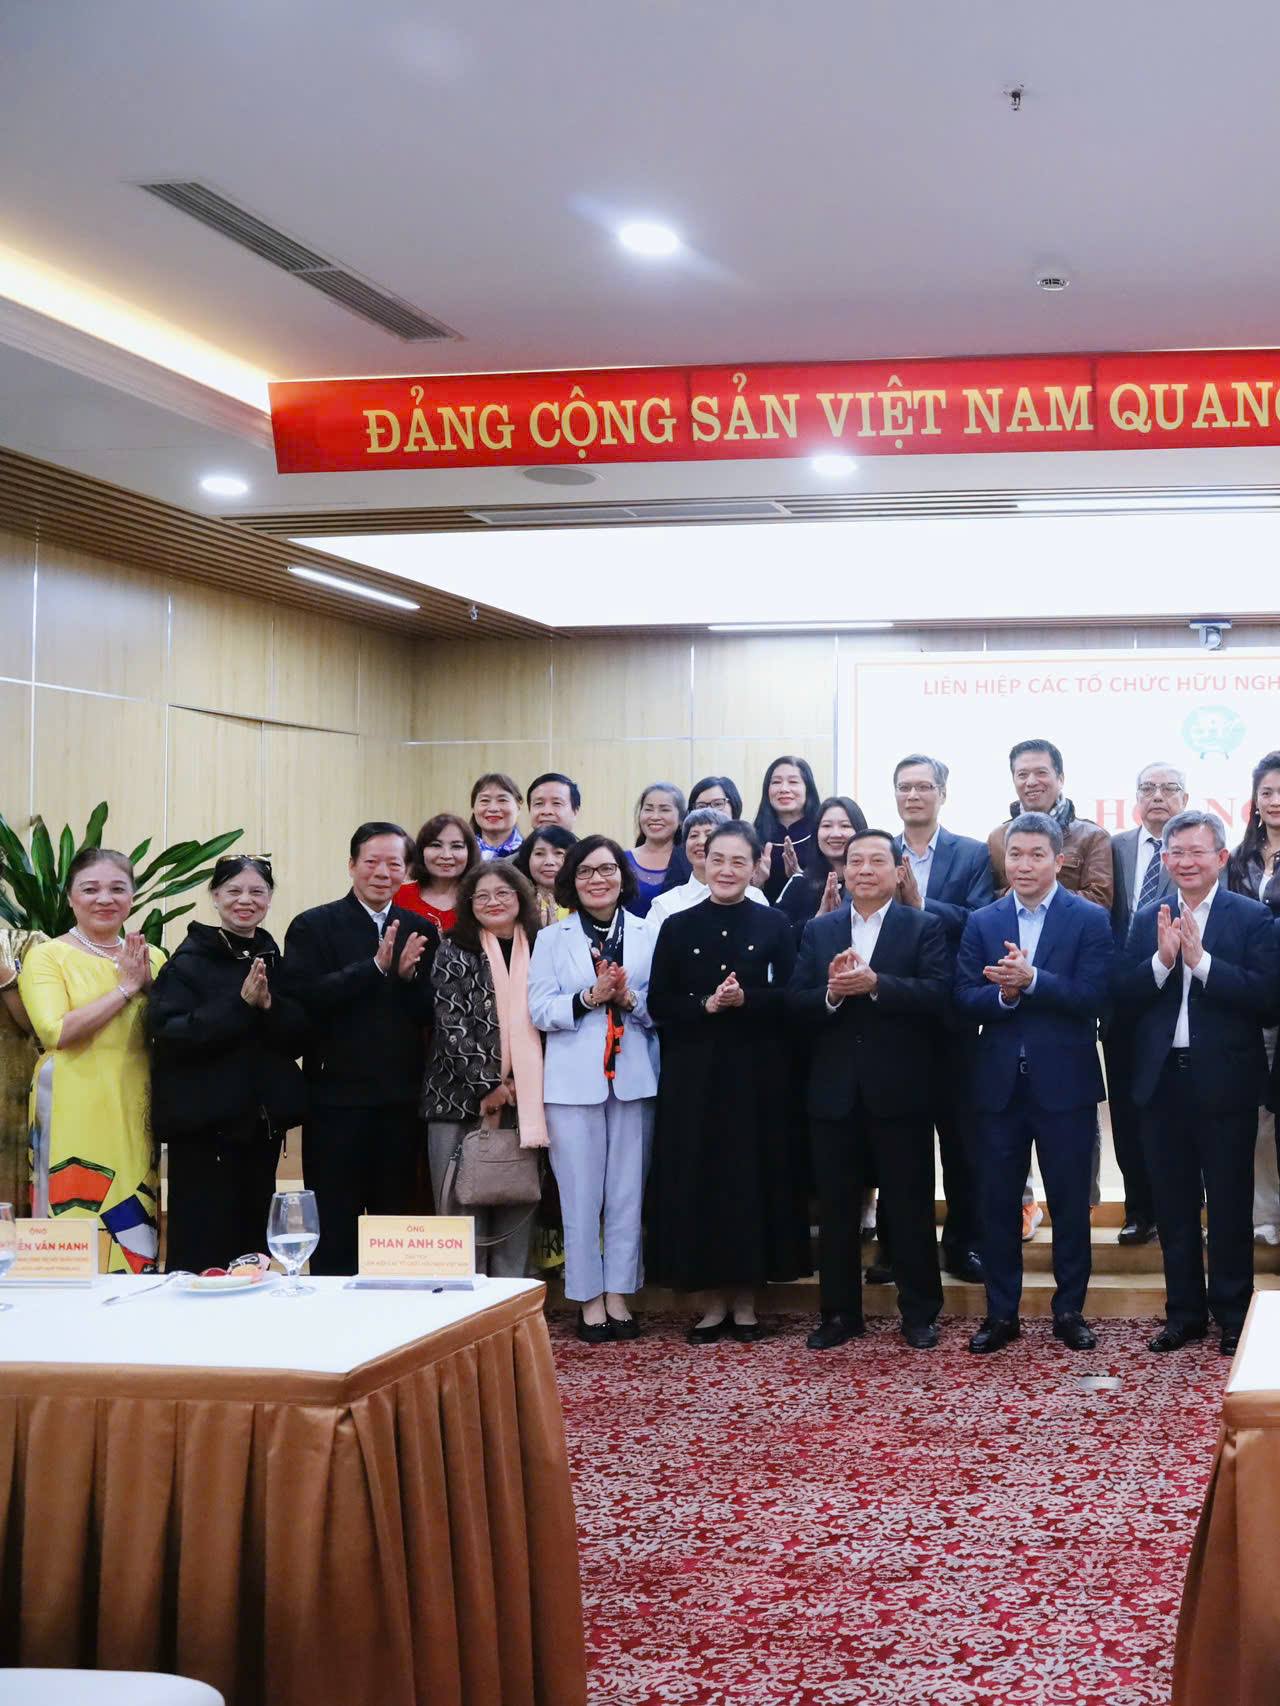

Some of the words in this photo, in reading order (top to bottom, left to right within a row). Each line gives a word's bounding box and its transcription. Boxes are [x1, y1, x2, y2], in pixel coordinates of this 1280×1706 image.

[362, 385, 515, 454] ĐẢNG
[529, 384, 677, 459] CỘNG
[690, 372, 800, 443] SẢN
[816, 374, 947, 449] VIỆT
[962, 385, 1095, 436] NAM
[1027, 672, 1069, 694] CÁC
[1108, 671, 1171, 693] CHỨC
[406, 1223, 425, 1233] ÔNG
[369, 1238, 404, 1249] PHAN
[407, 1238, 434, 1249] ANH
[437, 1237, 463, 1249] SƠN
